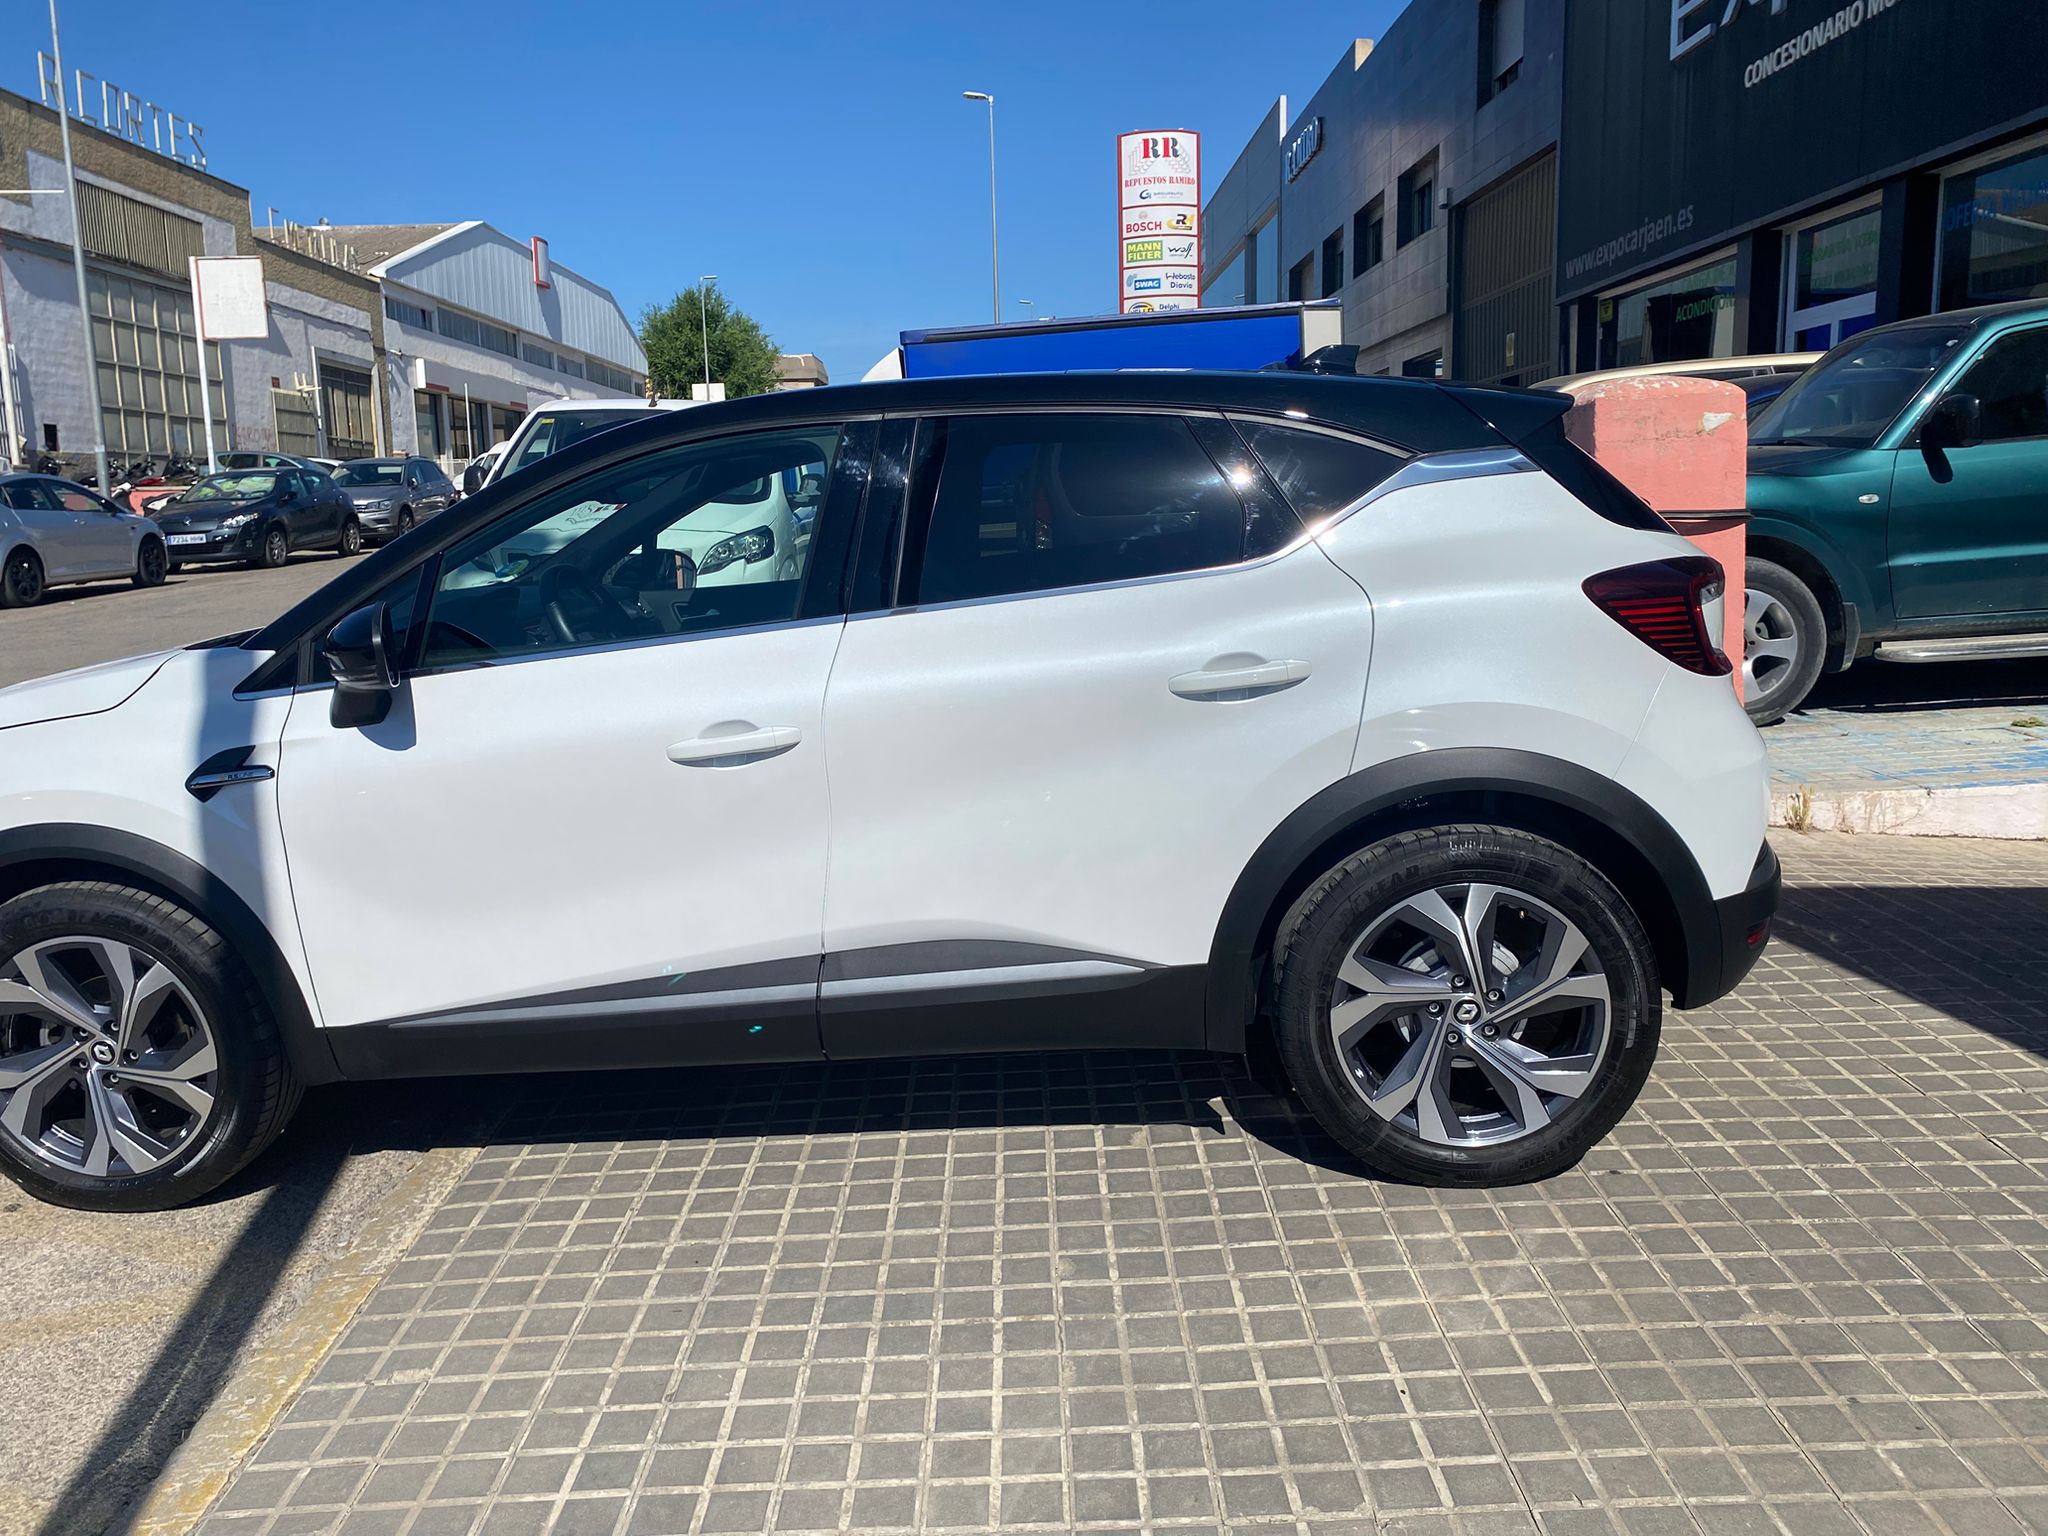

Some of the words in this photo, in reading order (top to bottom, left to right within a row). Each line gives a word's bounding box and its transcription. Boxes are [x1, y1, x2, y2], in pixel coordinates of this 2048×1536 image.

[1743, 0, 1866, 88] CONCESIONARIO
[75, 68, 208, 170] CORTES
[1124, 176, 1167, 188] REPUESTOS
[1168, 175, 1196, 185] RAMIRO
[1126, 221, 1162, 234] BOSCH
[1127, 241, 1161, 253] MANN
[1565, 204, 1694, 280] www.expocarjaen.es
[1127, 251, 1161, 261] FILTER
[1165, 272, 1196, 281] Webasto
[1135, 280, 1160, 289] SWAG
[1170, 281, 1193, 289] Diavia
[1159, 303, 1180, 311] Delphi
